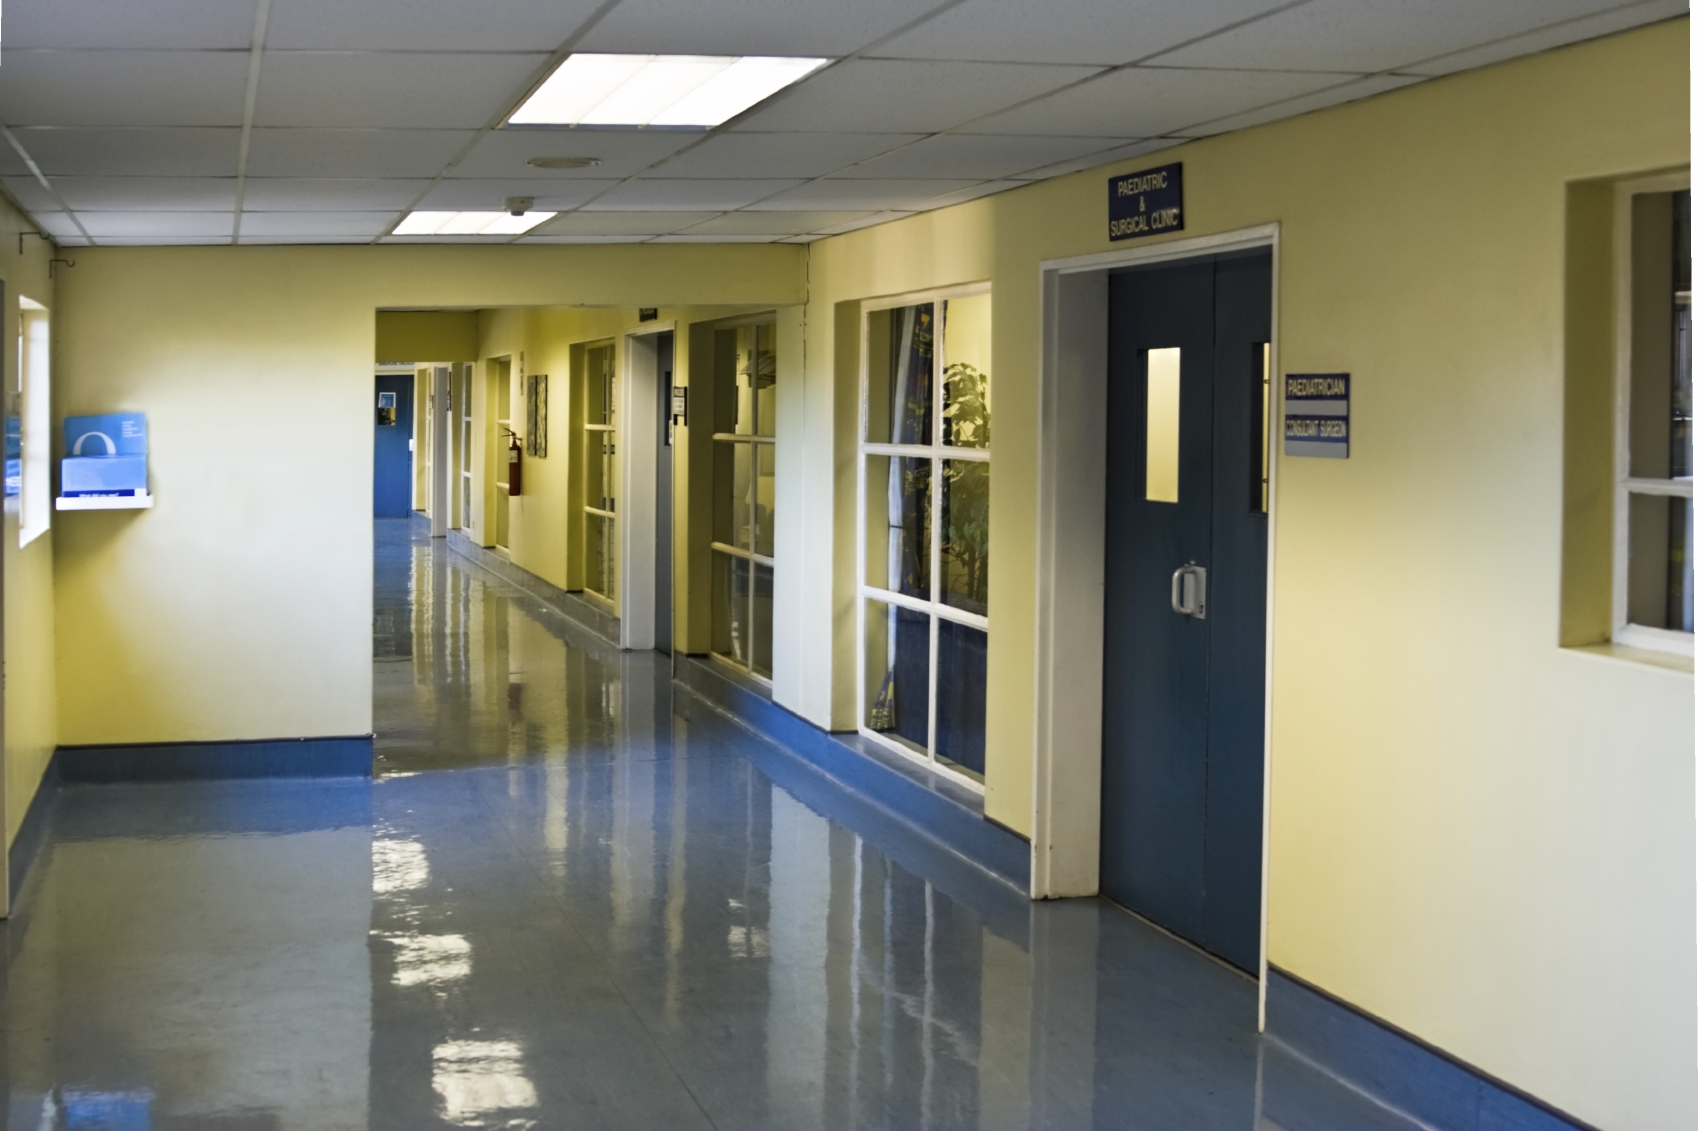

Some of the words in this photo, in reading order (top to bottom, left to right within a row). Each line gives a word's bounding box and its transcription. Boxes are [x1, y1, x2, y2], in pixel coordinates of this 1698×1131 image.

[1117, 171, 1168, 197] PAEDIATRIC
[1139, 196, 1146, 212] &
[1110, 214, 1149, 237] SURGICAL
[1151, 208, 1179, 230] CLINIC
[1287, 378, 1345, 396] PAEDIATRICIAN
[1286, 420, 1319, 436] CONSULTANT
